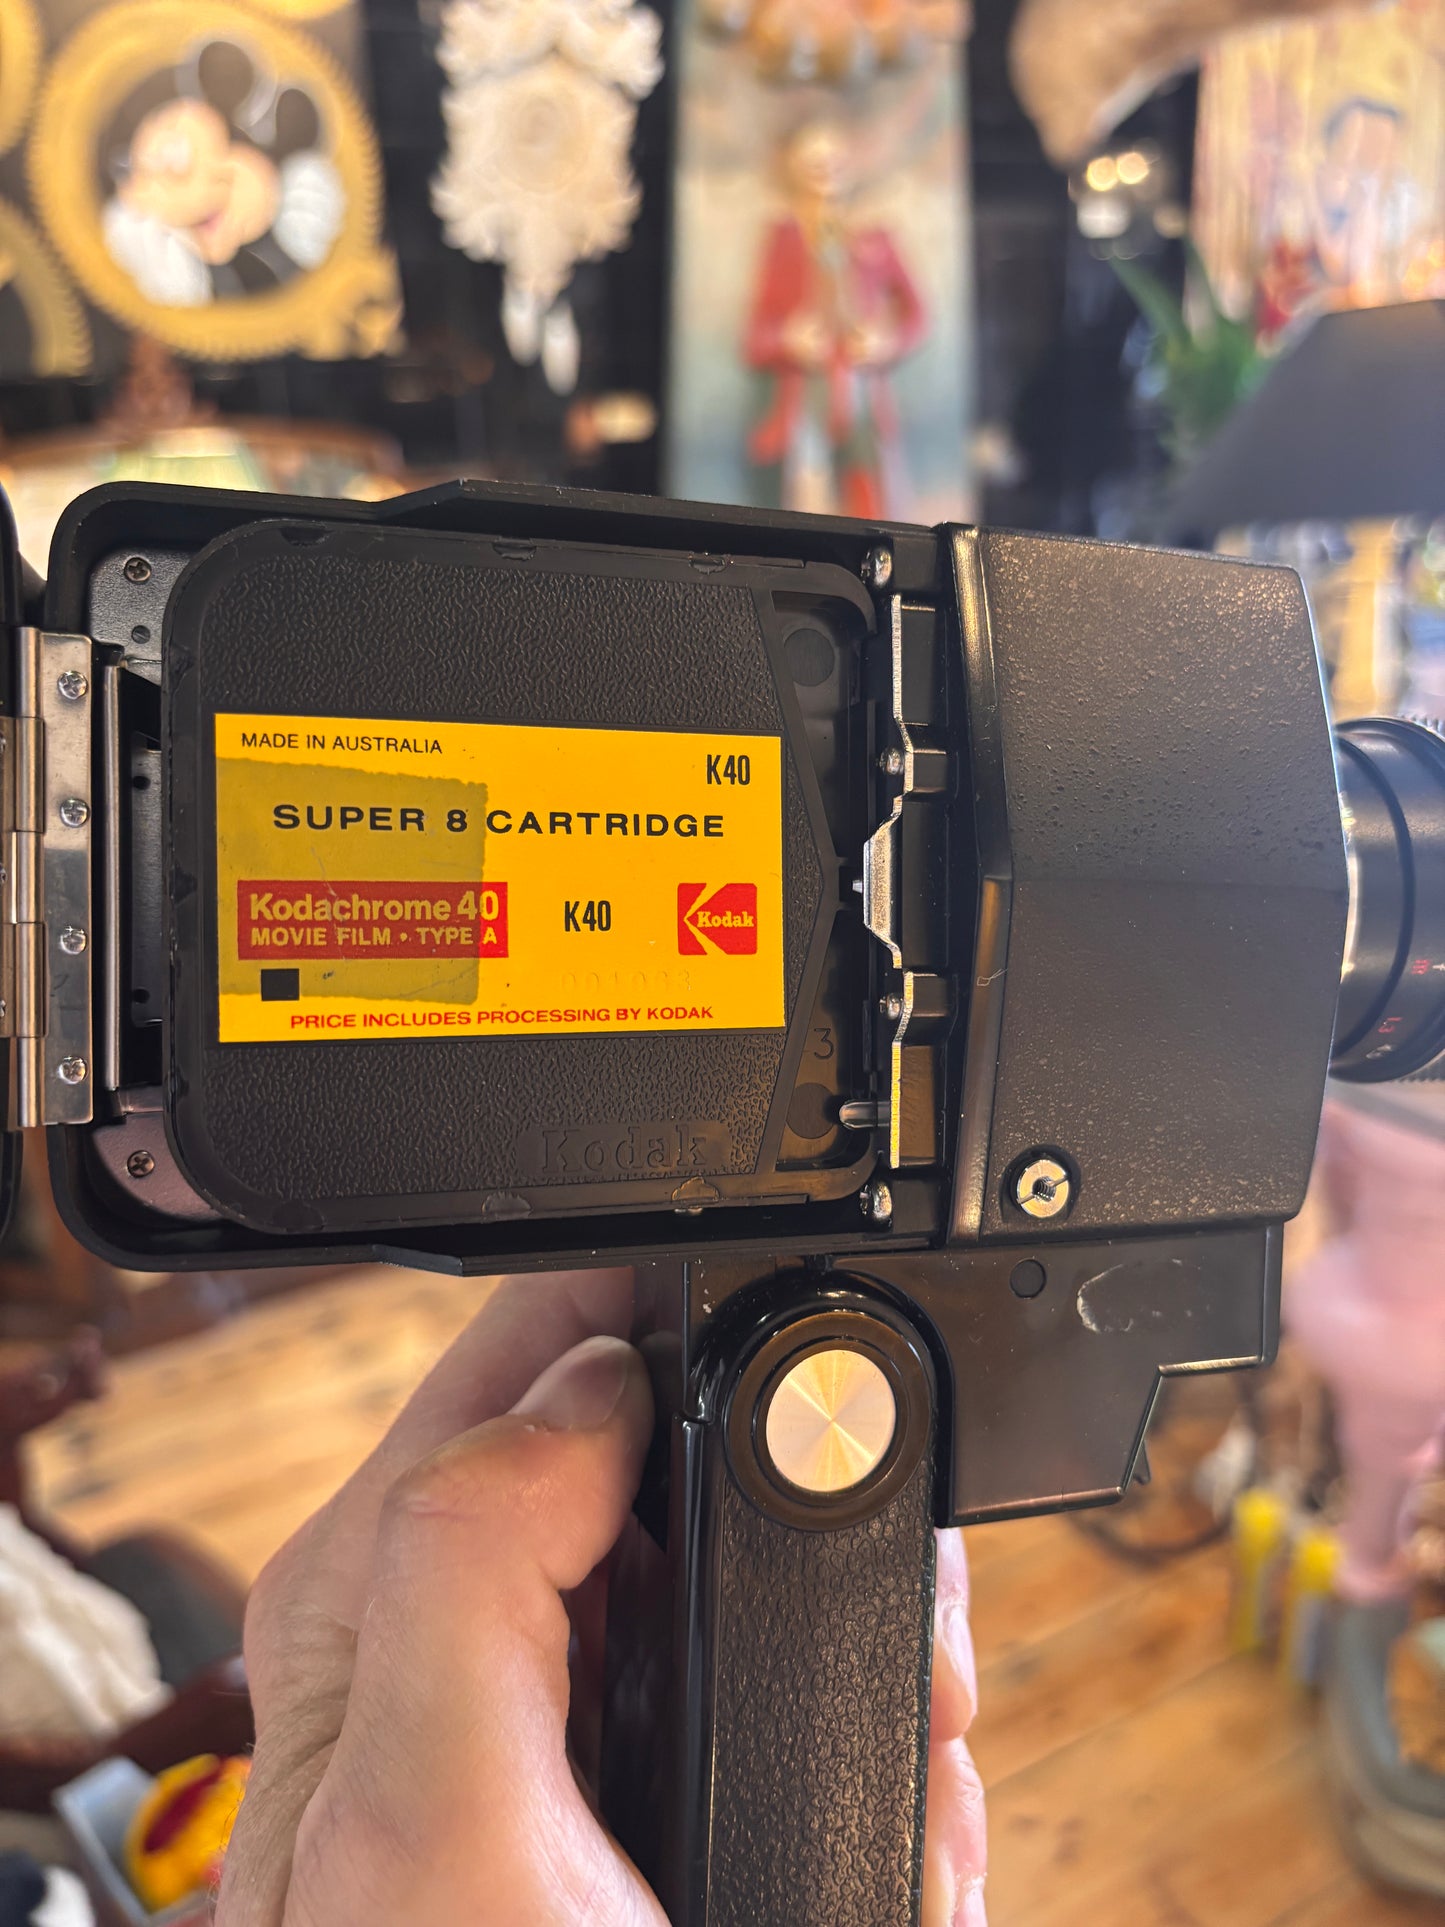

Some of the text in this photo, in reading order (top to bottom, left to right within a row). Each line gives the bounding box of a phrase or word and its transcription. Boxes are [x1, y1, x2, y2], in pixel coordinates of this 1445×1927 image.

[241, 733, 442, 754] MADE IN AUSTRALIA
[707, 754, 750, 785] K40
[273, 804, 724, 837] SUPER 8 CARTRIDGE
[251, 890, 499, 921] Kodachrome 40
[564, 900, 611, 932] K40
[697, 911, 754, 928] Kodak
[251, 927, 497, 946] MOVIE FILM TYPE A
[291, 1006, 713, 1029] PRICE INCLUDES PROCESSING BY KODAK
[814, 1028, 834, 1060] 3
[542, 1124, 707, 1173] Kodak
